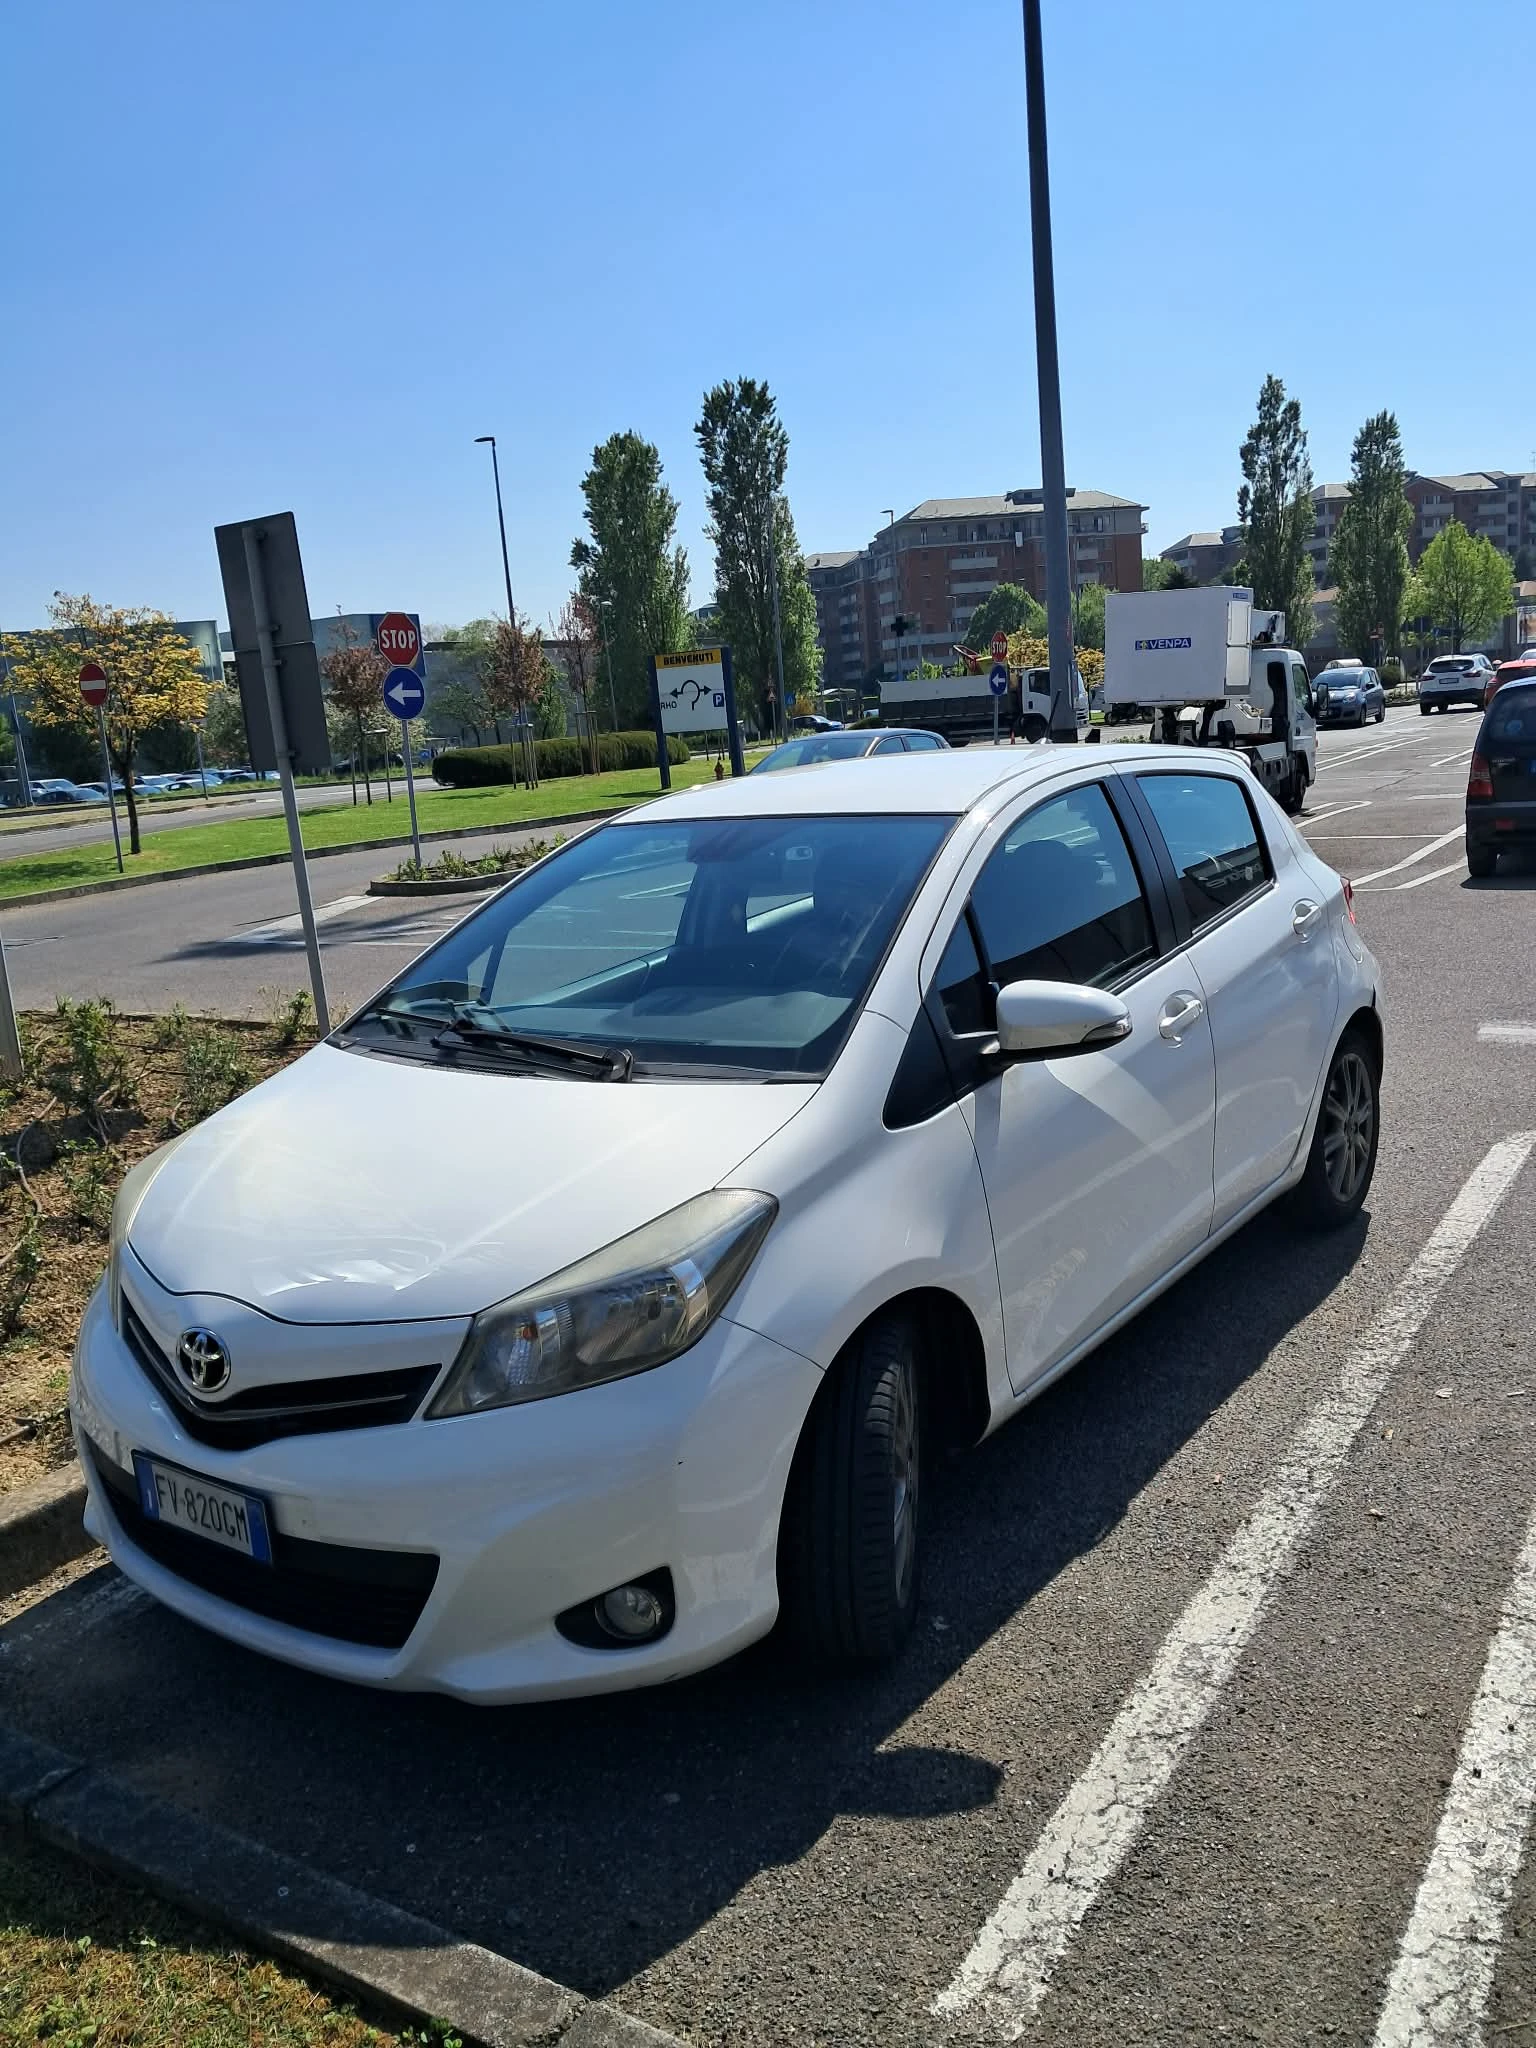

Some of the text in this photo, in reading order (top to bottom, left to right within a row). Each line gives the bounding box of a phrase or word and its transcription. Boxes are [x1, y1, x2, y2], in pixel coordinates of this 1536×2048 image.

[381, 629, 416, 648] STOP
[1150, 639, 1190, 648] VENPA
[992, 641, 1007, 653] STOP
[664, 653, 714, 665] BENVENUTI
[661, 701, 677, 709] RHO
